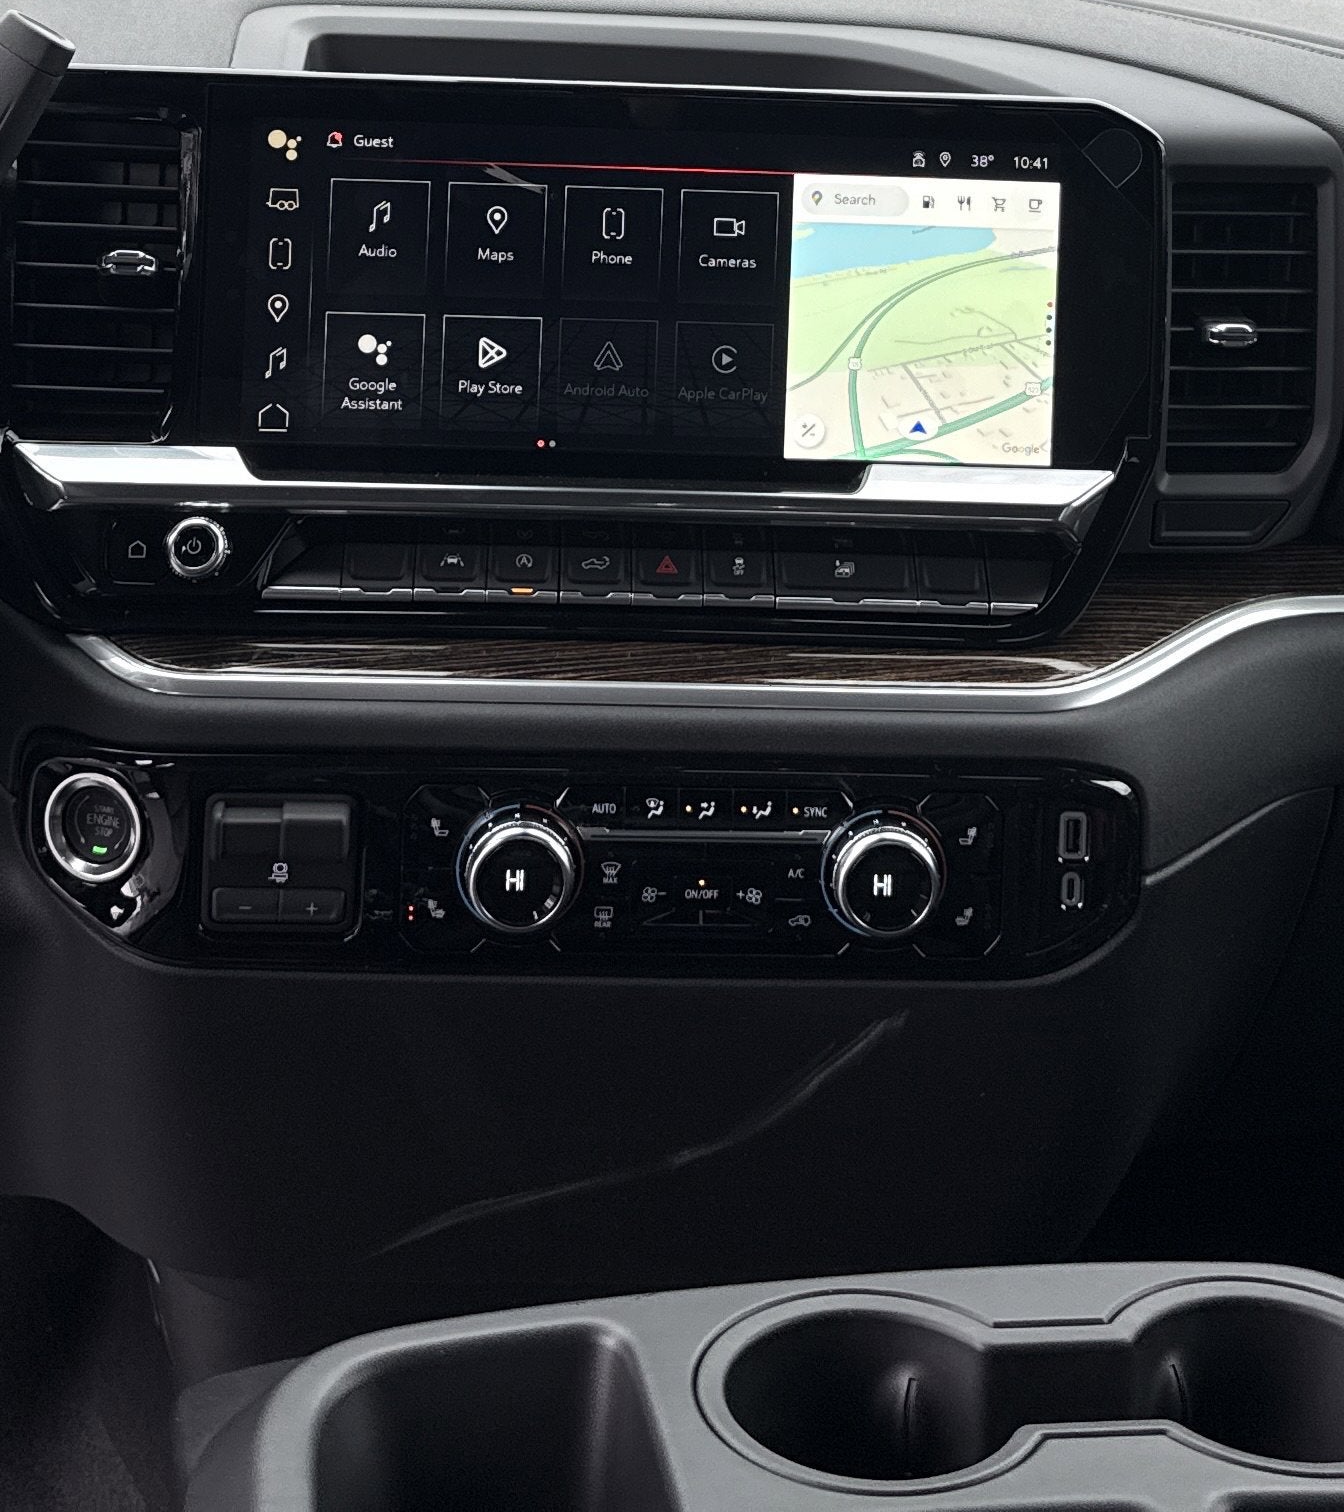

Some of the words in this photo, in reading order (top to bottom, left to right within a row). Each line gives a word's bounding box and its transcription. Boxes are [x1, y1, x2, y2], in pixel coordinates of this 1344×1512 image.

[353, 134, 394, 149] Guest
[970, 154, 995, 168] 38°
[1013, 156, 1049, 171] 10:41
[834, 193, 876, 206] Search
[358, 243, 397, 258] Audio
[477, 247, 514, 264] Maps
[591, 250, 633, 266] Phone
[698, 254, 757, 269] Cameras
[348, 377, 397, 395] Google
[457, 379, 485, 398] Play
[488, 380, 523, 395] Store
[563, 383, 615, 398] Android
[617, 384, 649, 399] Auto
[677, 386, 716, 402] Apple
[718, 386, 769, 404] CarPlay
[340, 395, 404, 411] Assistant
[1001, 442, 1040, 456] Google
[95, 804, 115, 814] START
[591, 803, 617, 815] AUTO
[804, 806, 828, 818] SYNC
[86, 813, 120, 829] ENGINE
[95, 826, 113, 837] STOP
[505, 869, 525, 892] HI
[788, 868, 805, 879] A/C
[873, 874, 892, 897] HI
[684, 889, 719, 900] ON/OFF
[594, 920, 612, 929] REAR
